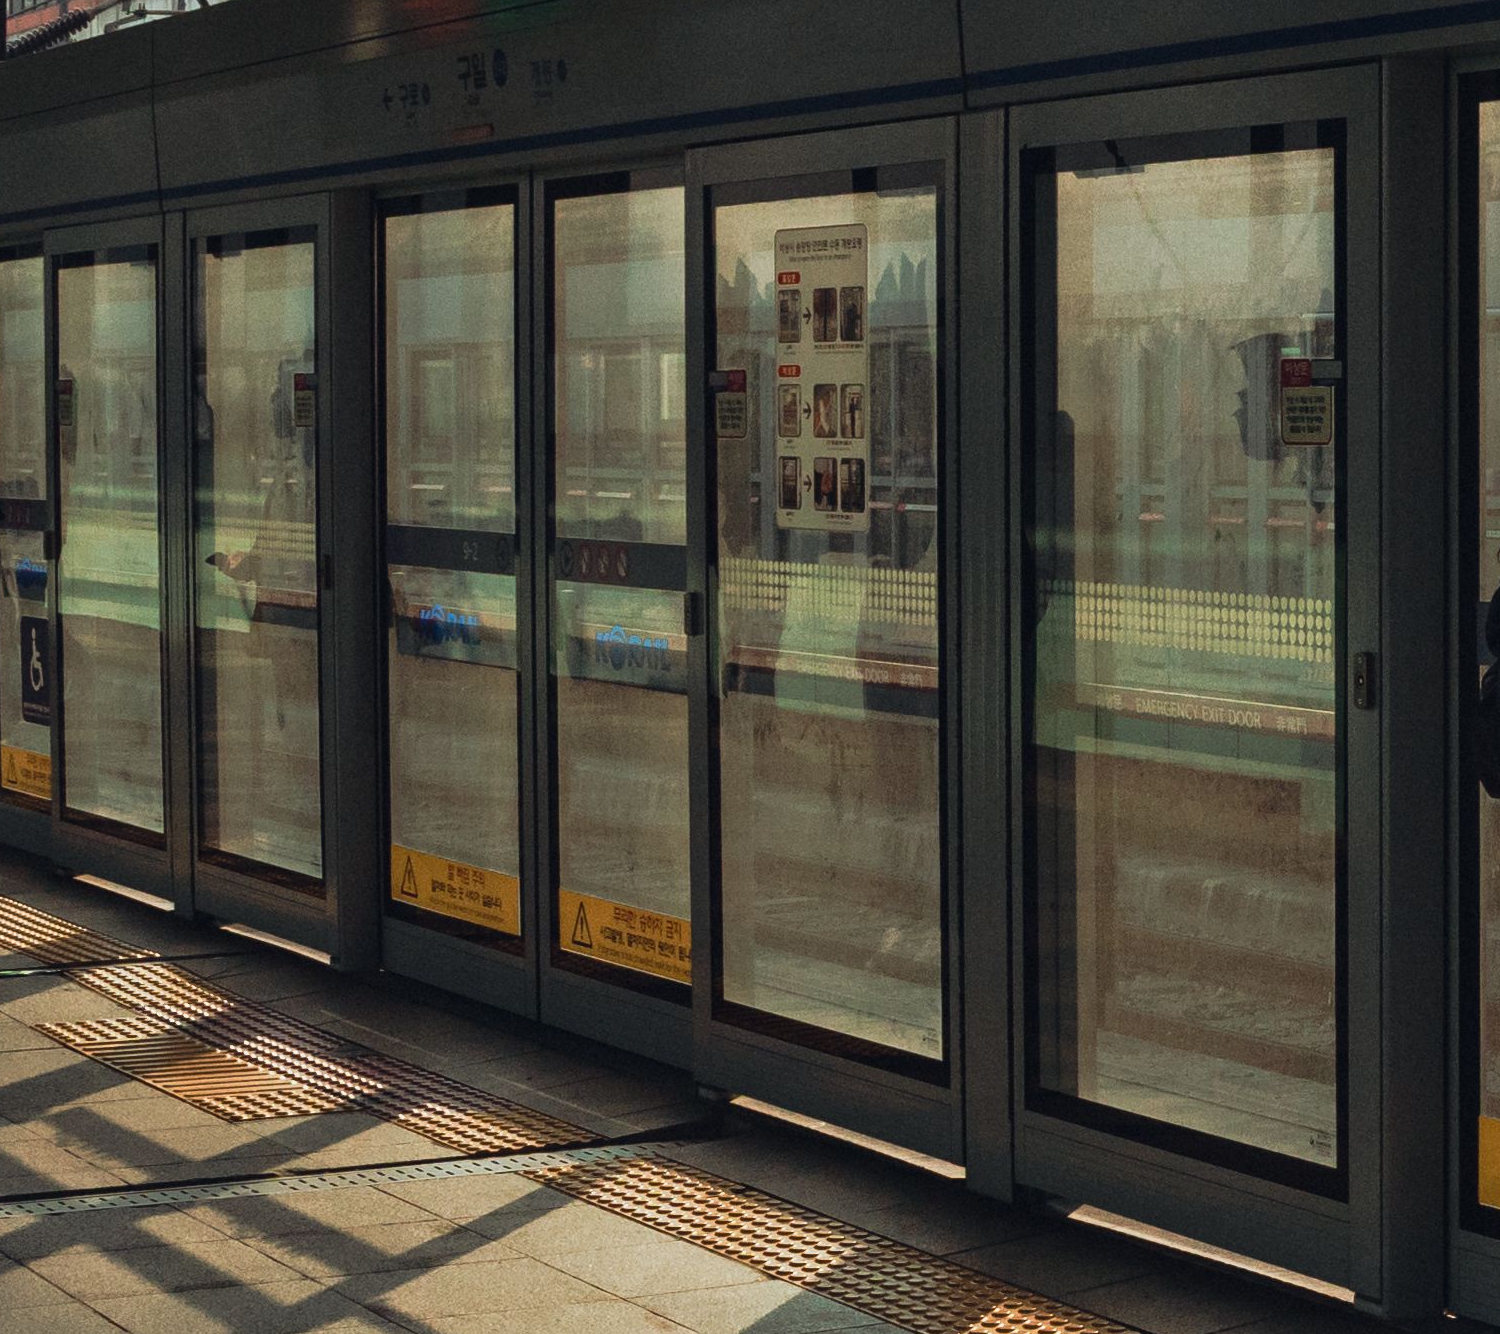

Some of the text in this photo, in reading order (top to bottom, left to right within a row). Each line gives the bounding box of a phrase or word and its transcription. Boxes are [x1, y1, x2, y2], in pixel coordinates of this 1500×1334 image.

[595, 624, 672, 670] KORAIL
[1135, 697, 1197, 720] EMERGENCY
[1201, 705, 1225, 722] EXIT
[1228, 710, 1263, 729] DOOR
